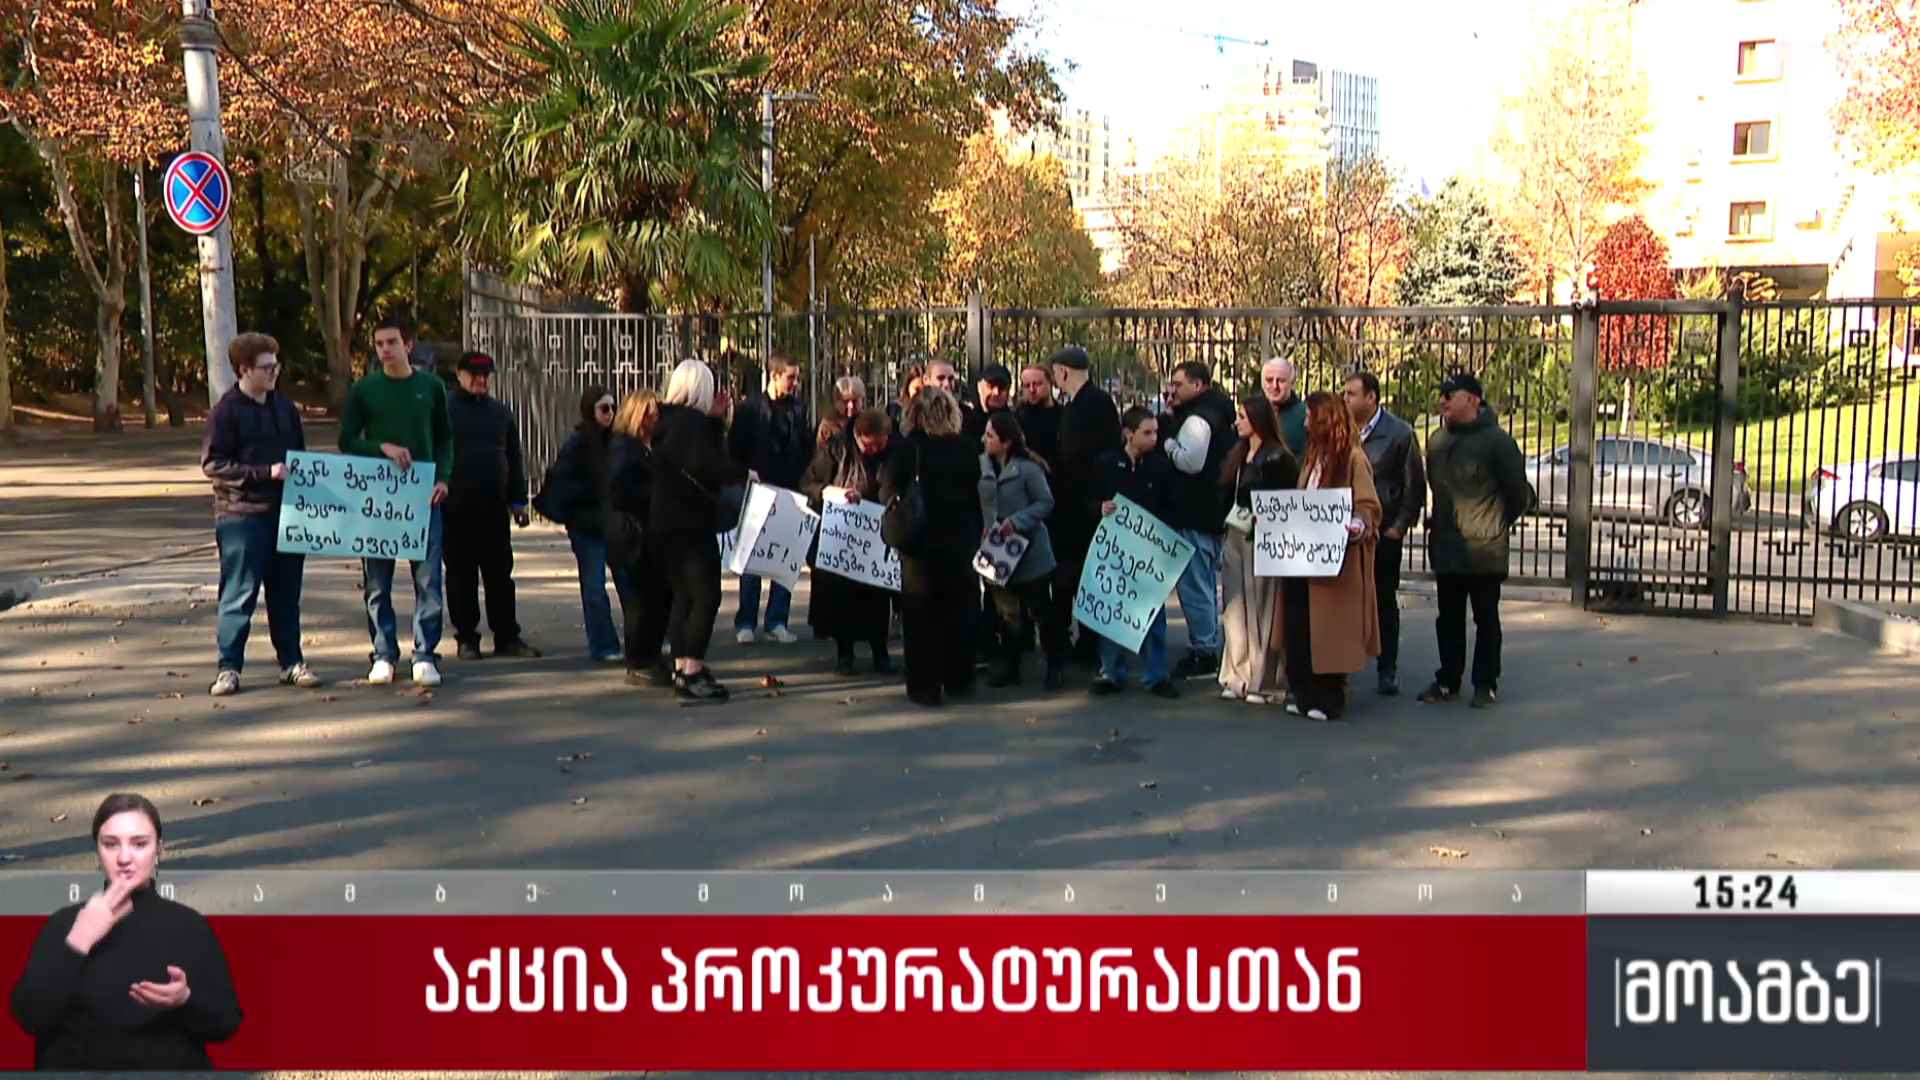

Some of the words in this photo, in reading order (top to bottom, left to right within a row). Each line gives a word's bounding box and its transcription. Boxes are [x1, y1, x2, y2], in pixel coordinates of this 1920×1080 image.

[289, 457, 330, 488] ჩვენს
[361, 497, 416, 522] მამის
[285, 526, 343, 551] ნახვის
